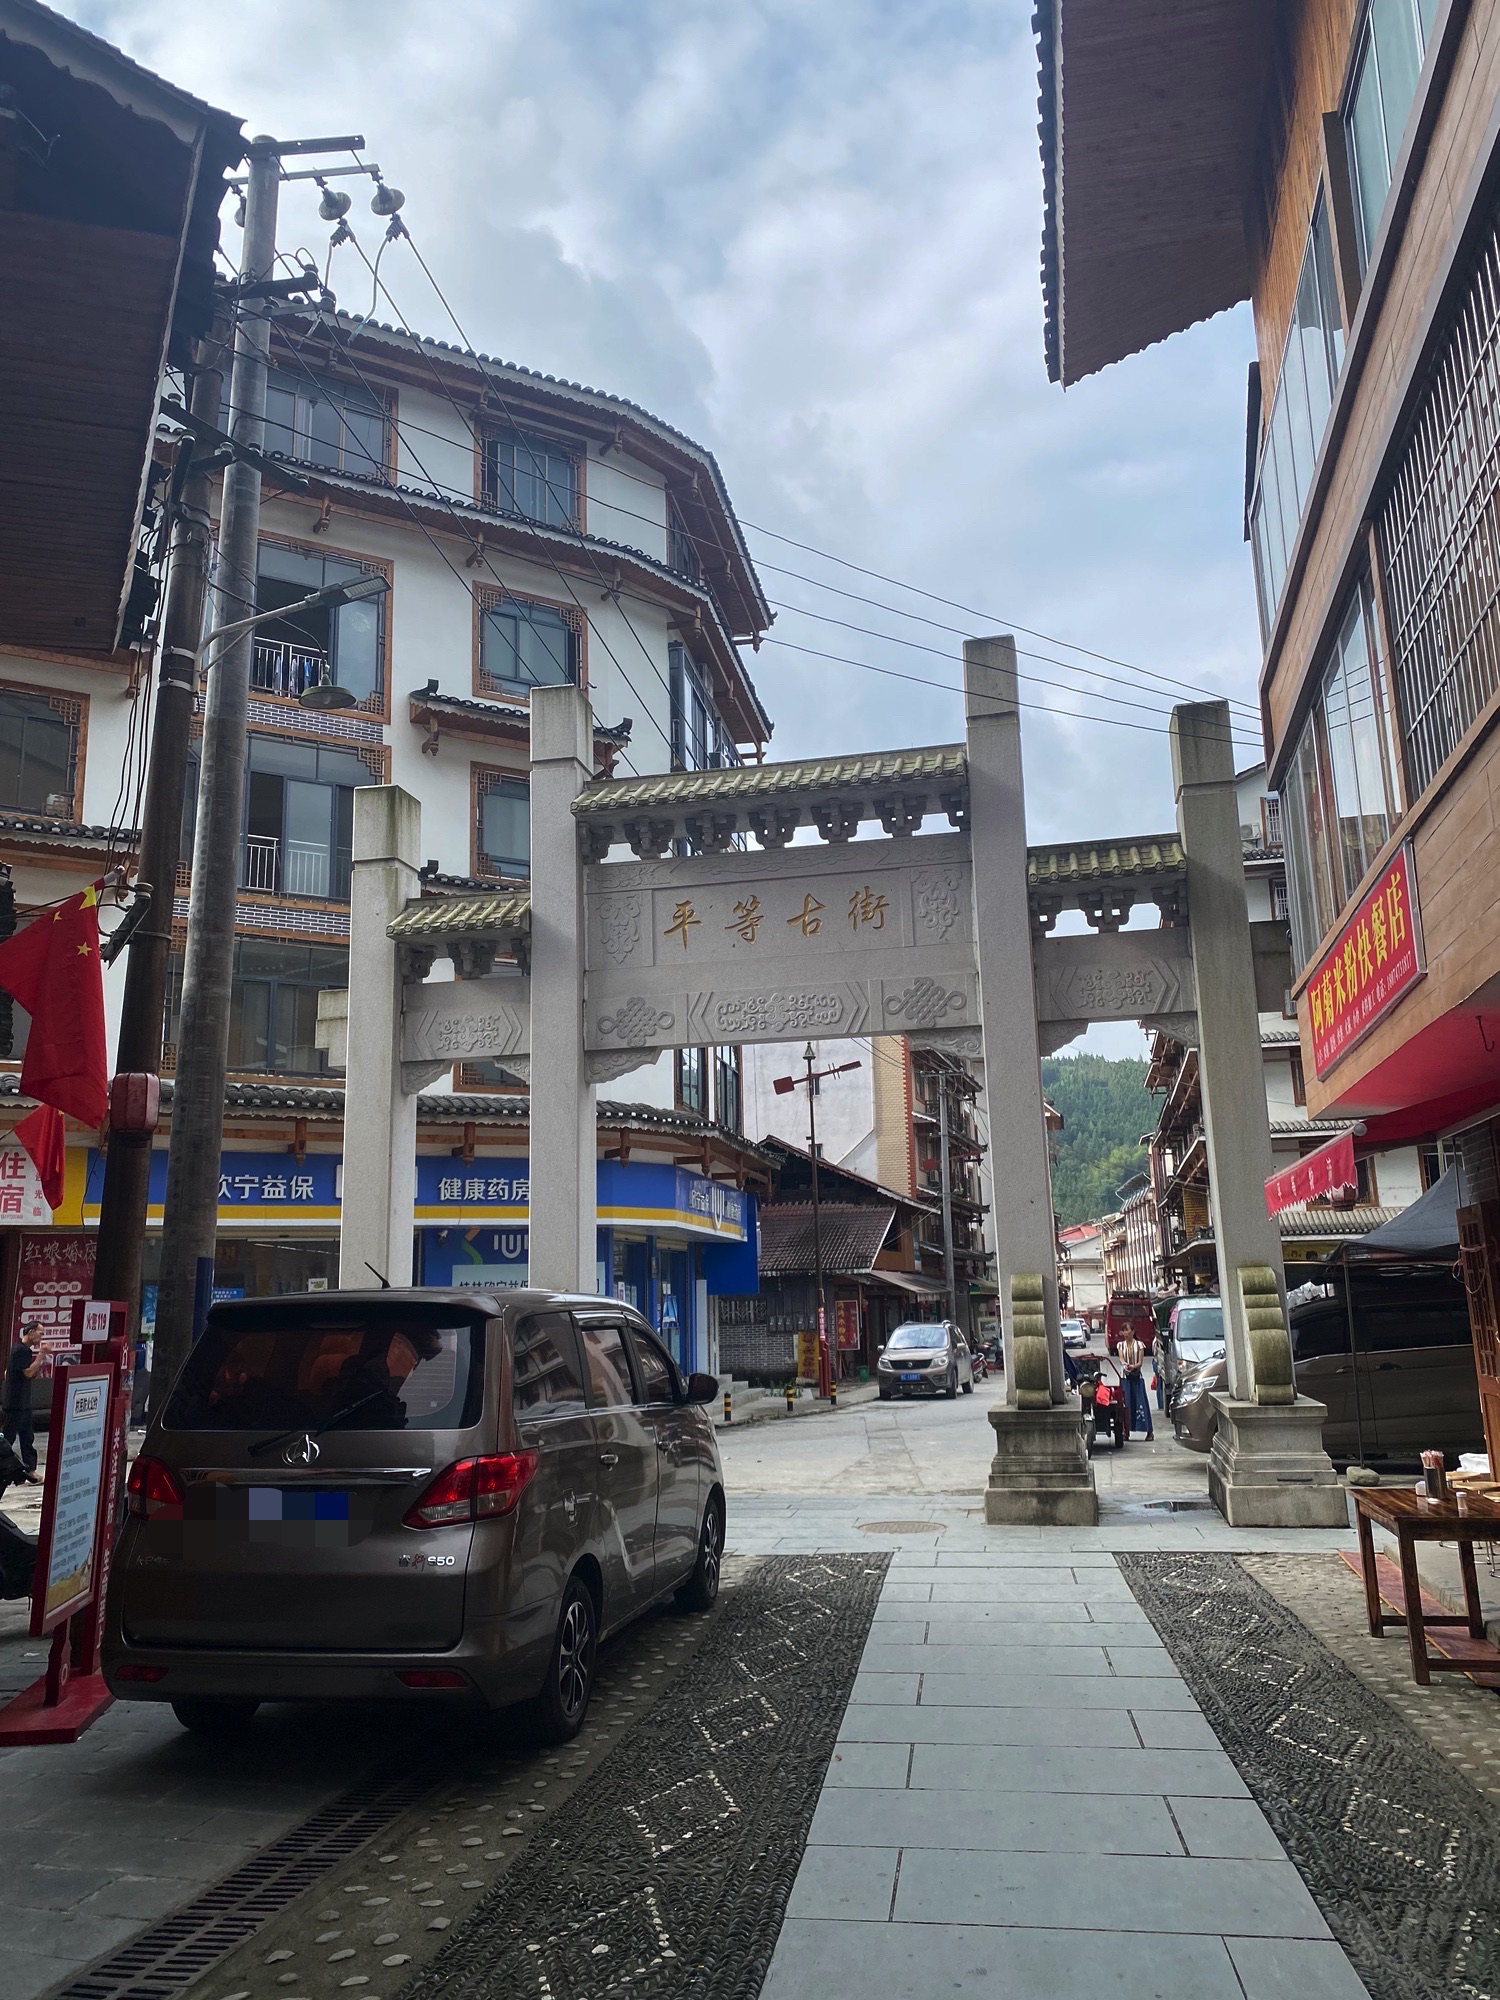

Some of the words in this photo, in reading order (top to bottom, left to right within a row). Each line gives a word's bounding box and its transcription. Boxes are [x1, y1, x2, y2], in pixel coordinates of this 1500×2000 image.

[663, 886, 891, 949] 平等古街
[1311, 872, 1405, 1043] 阿菊米粉快餐店
[438, 1177, 529, 1201] 健康药房
[86, 1314, 107, 1331] 火警119
[427, 1556, 455, 1566] S50
